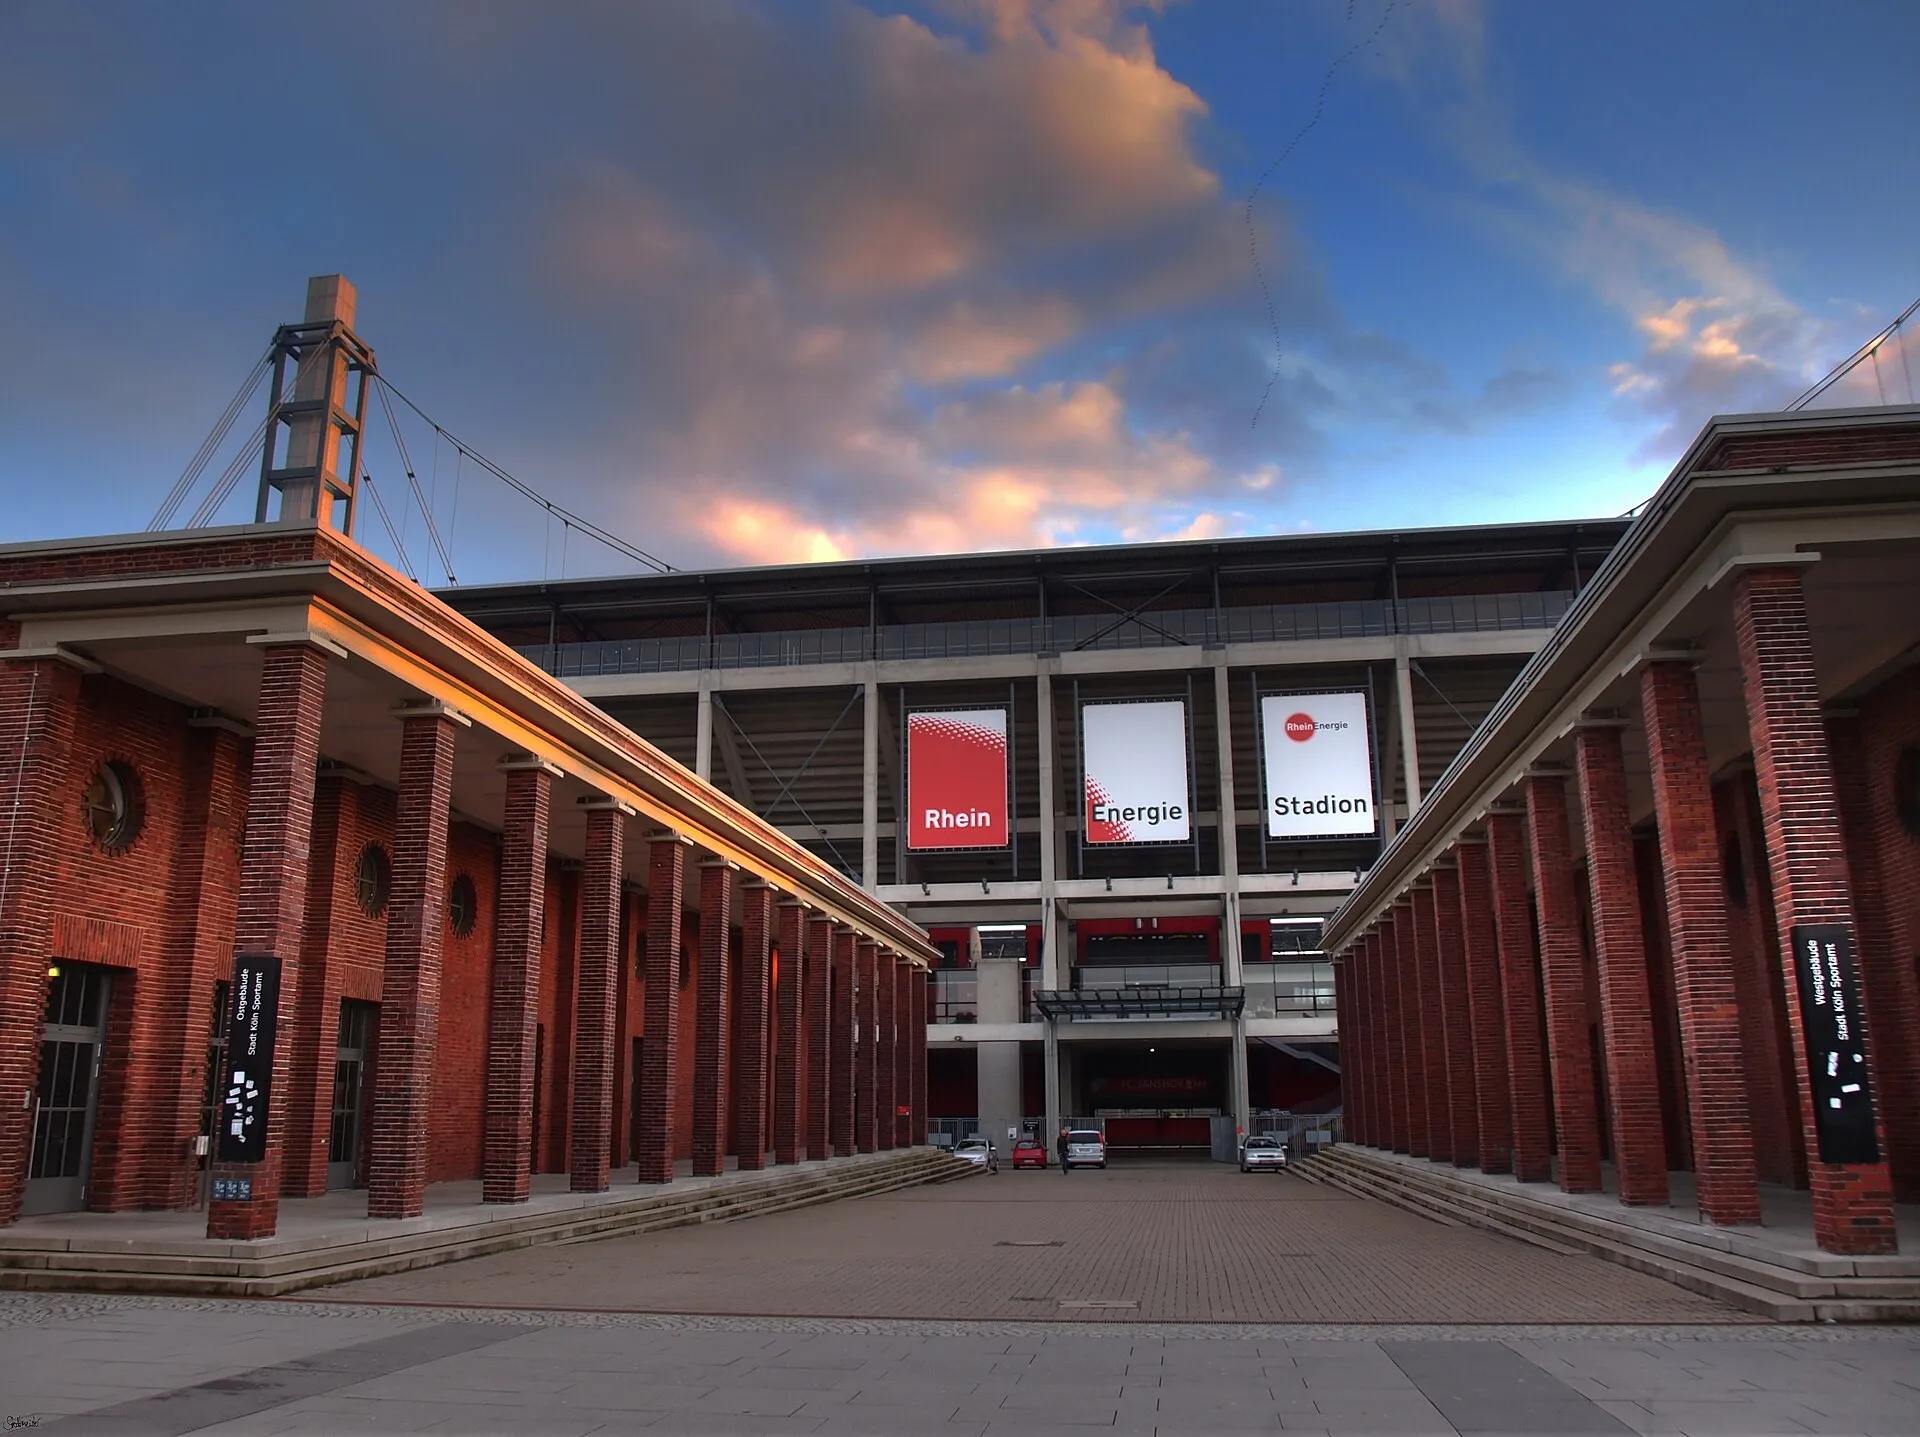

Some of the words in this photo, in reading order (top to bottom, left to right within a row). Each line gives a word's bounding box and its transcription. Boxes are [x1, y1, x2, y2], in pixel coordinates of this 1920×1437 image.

[1286, 720, 1349, 733] RheinEnergie
[1092, 801, 1183, 826] Energie
[1273, 795, 1368, 817] Stadion
[924, 808, 991, 830] Rhein
[1807, 939, 1826, 1006] Westgebäude
[1825, 943, 1843, 988] Sportamt
[236, 968, 250, 1021] Ostgebäude
[252, 972, 263, 1011] Sportamt
[1832, 990, 1844, 1012] Köln
[250, 1011, 260, 1031] Köln
[1835, 1014, 1849, 1041] Stadt
[247, 1033, 258, 1056] Stadt
